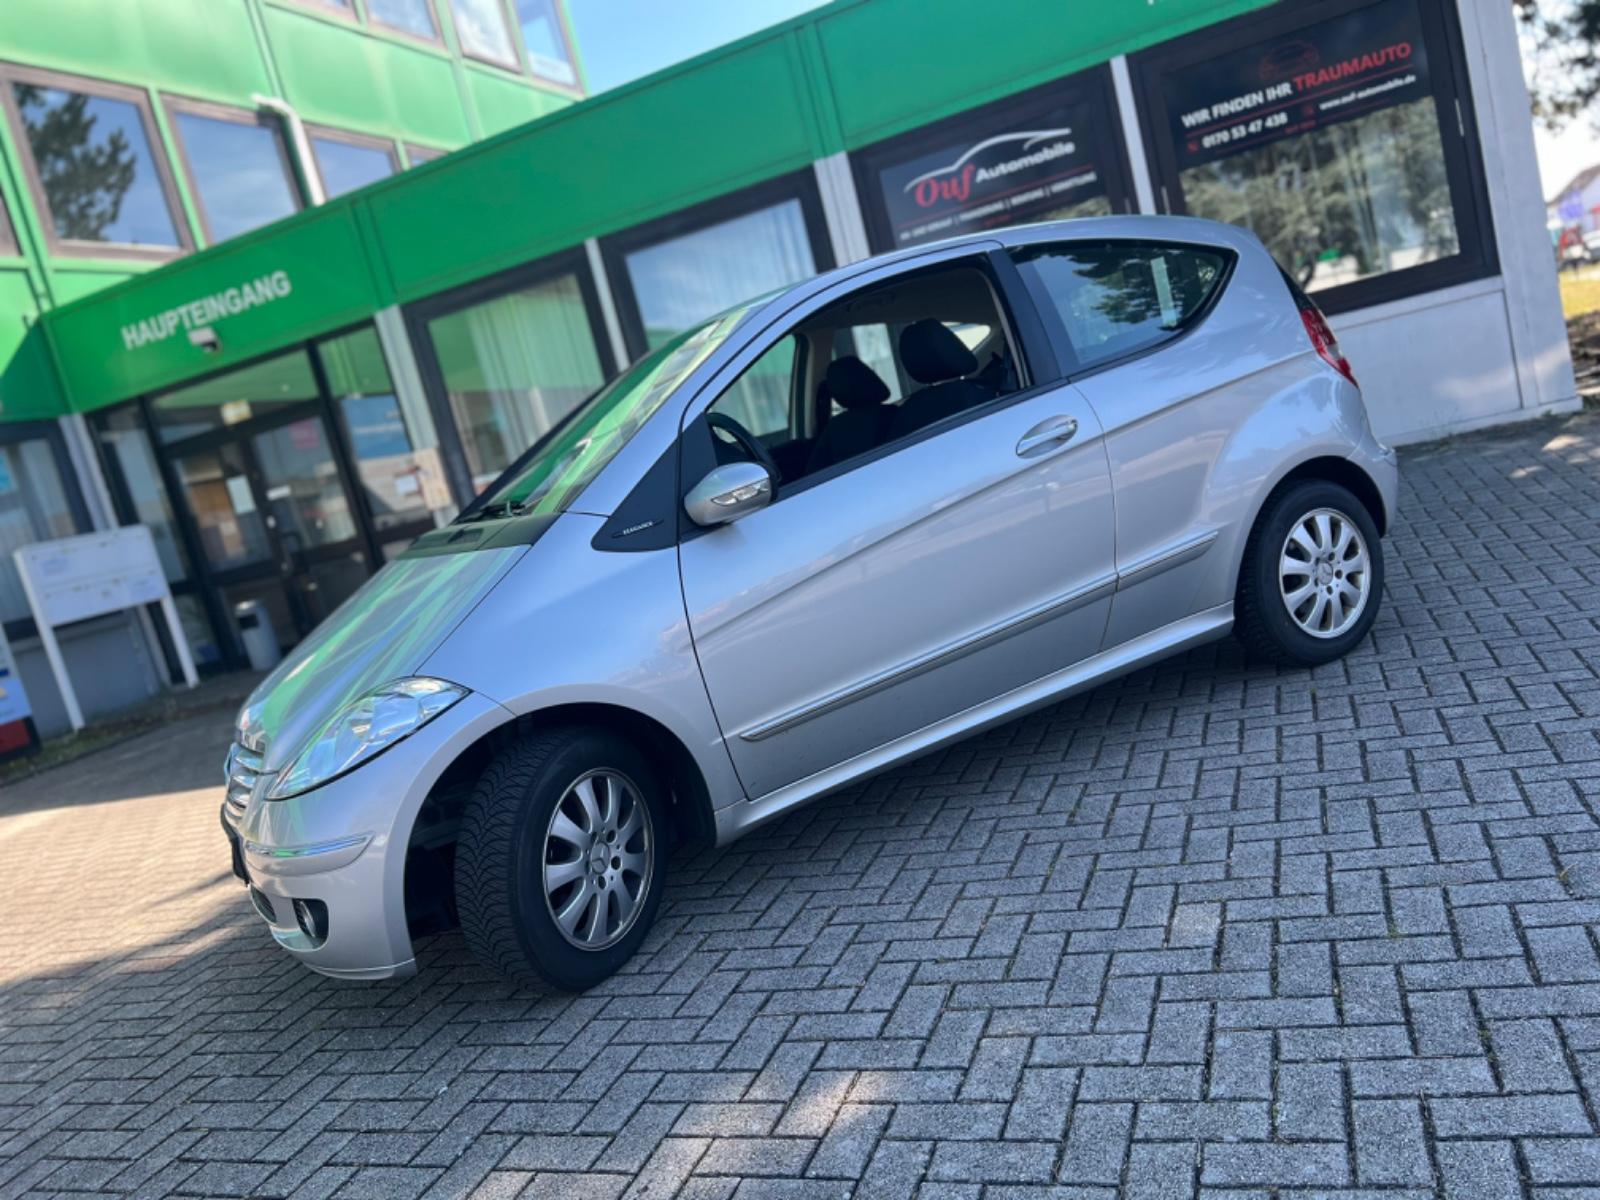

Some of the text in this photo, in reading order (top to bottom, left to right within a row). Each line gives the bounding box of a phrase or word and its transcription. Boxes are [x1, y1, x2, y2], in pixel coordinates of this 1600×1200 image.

[1181, 42, 1411, 128] WIR FINDEN IHR TRAUMAUTO
[914, 162, 975, 208] Ouf
[975, 142, 1076, 183] Automobile
[121, 270, 292, 350] HAUPTEINGANG
